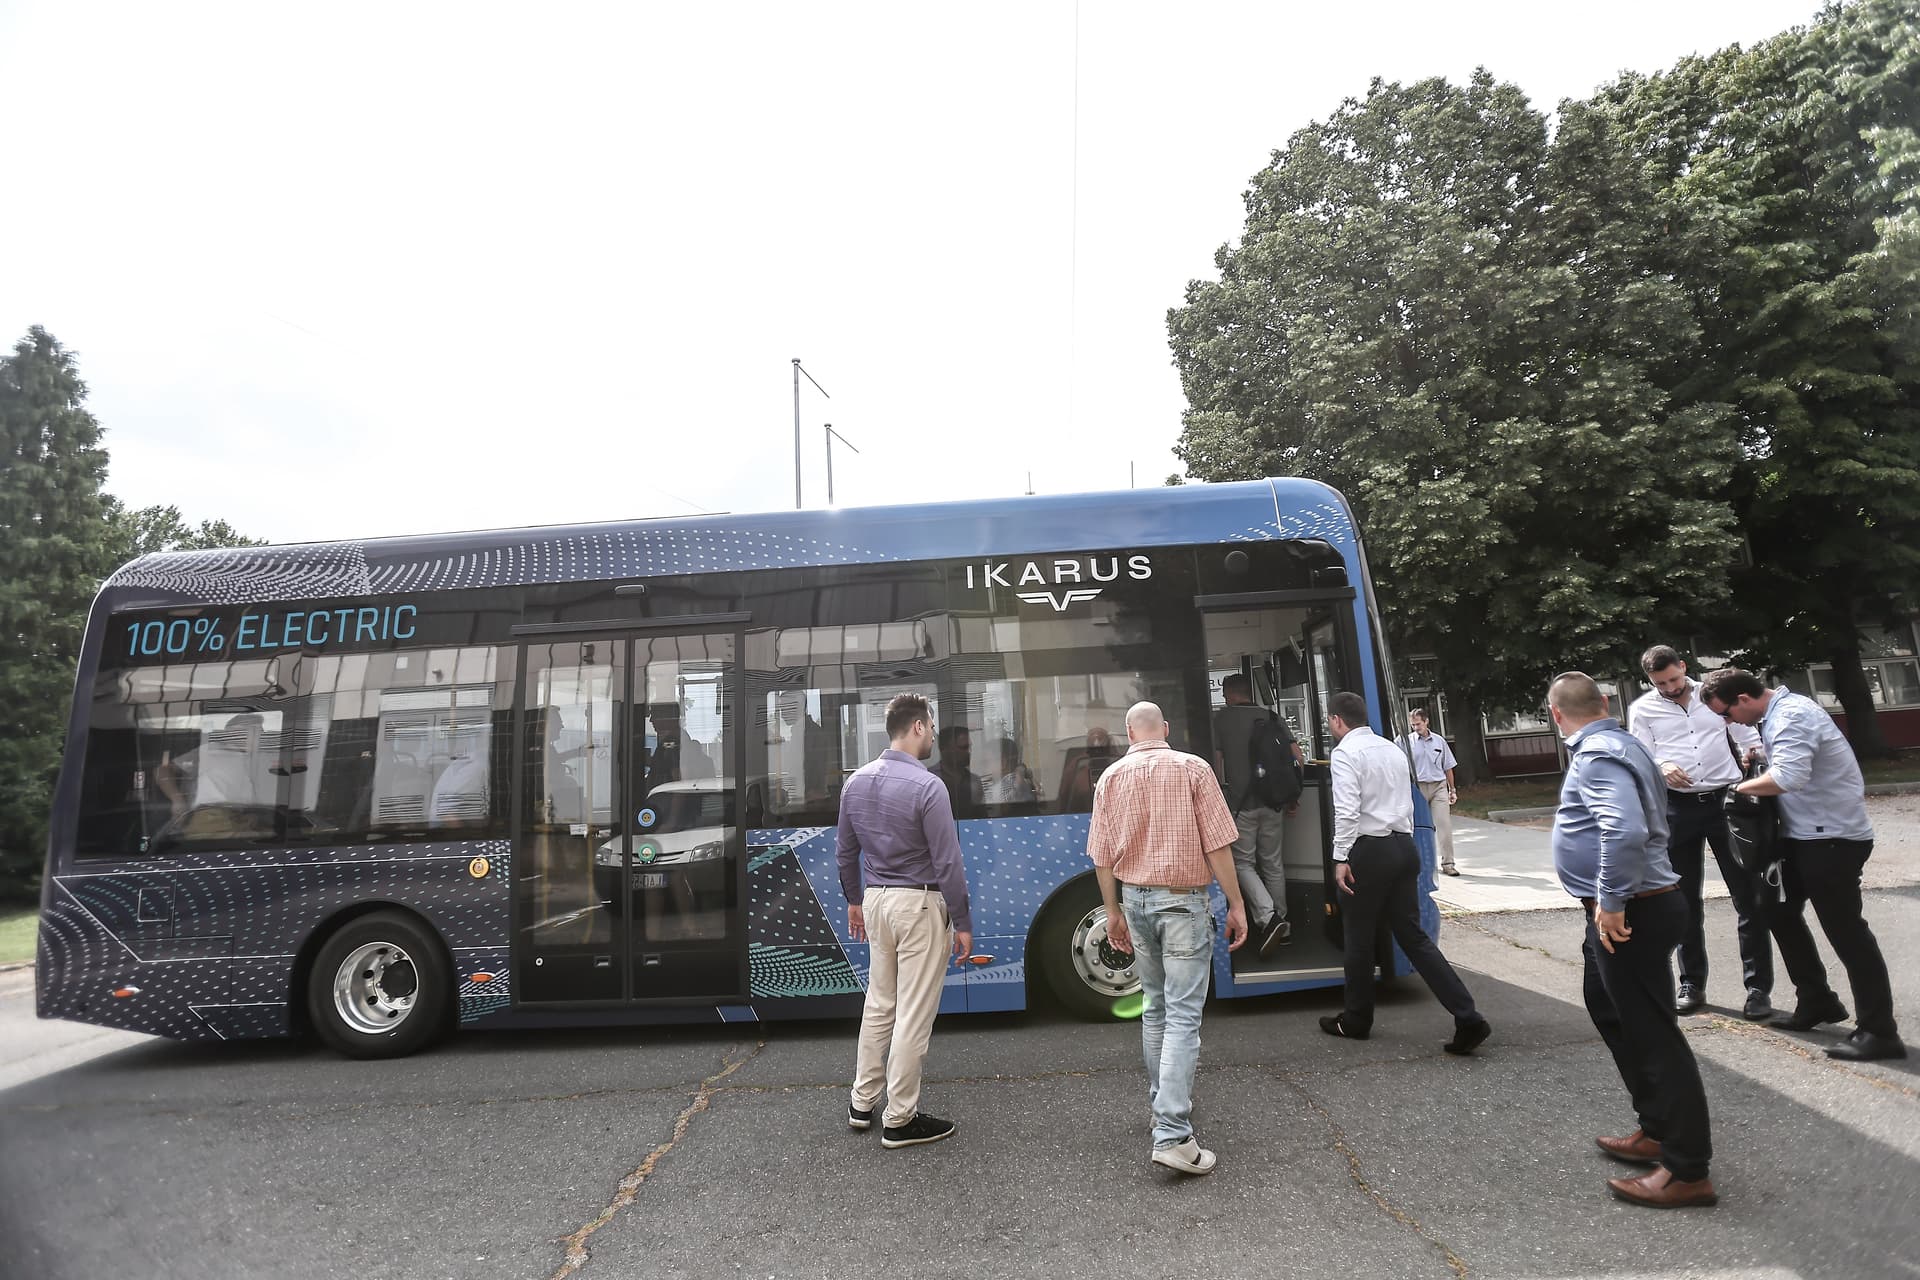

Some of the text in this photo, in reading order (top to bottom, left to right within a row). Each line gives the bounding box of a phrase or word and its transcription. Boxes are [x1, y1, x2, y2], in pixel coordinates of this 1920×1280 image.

[966, 555, 1152, 589] IKARUS
[127, 604, 417, 656] 100% ELECTRIC
